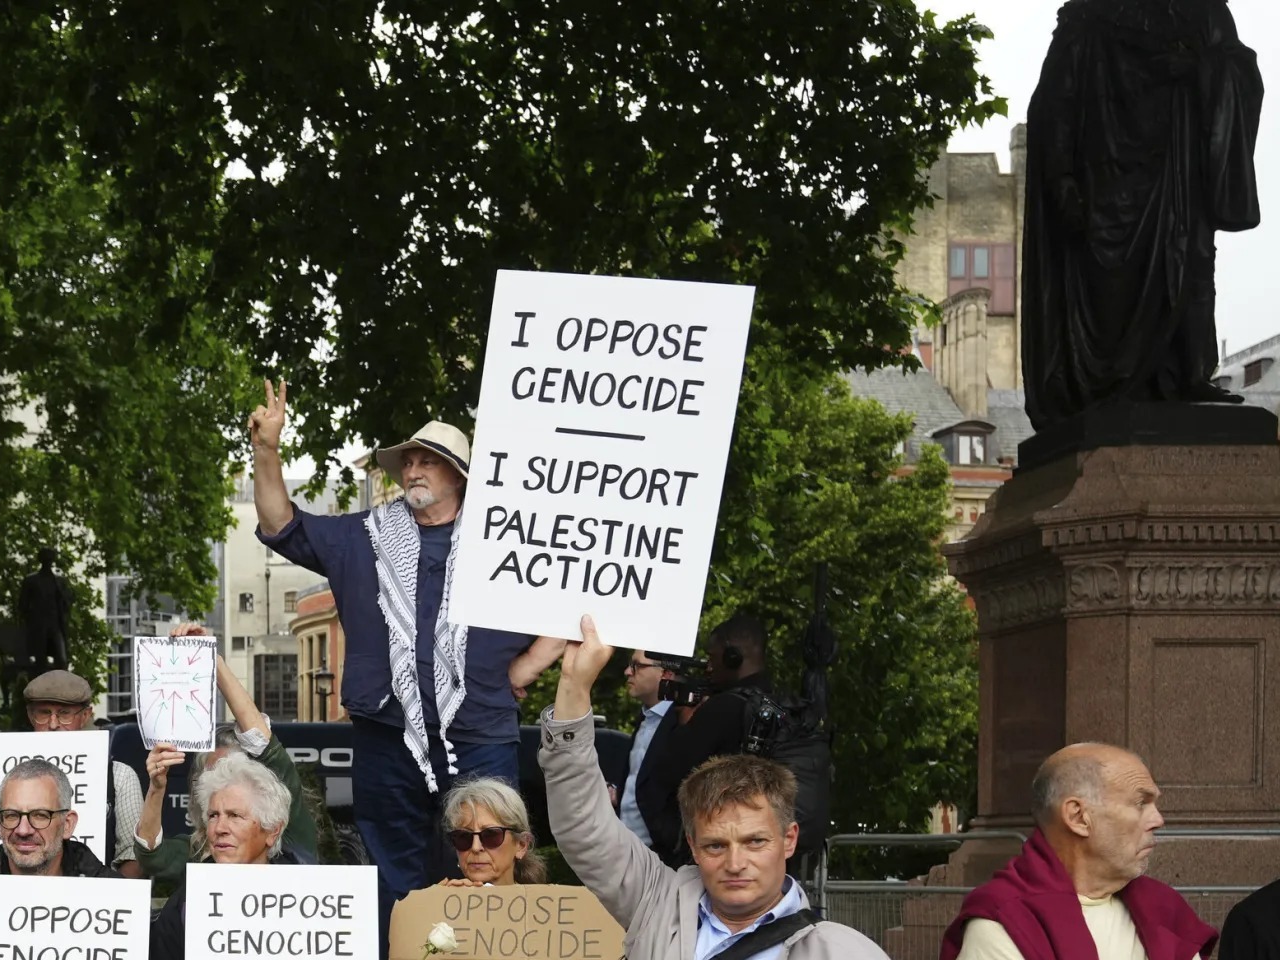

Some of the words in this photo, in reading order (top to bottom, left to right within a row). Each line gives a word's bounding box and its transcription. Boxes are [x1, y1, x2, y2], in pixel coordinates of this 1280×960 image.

[511, 312, 536, 347] I
[557, 318, 707, 362] OPPOSE
[512, 367, 704, 415] GENOCIDE
[486, 452, 508, 486] I
[523, 456, 698, 506] SUPPORT
[484, 506, 683, 564] PALESTINE
[489, 551, 652, 600] ACTION
[8, 905, 133, 936] OPPOSE
[208, 892, 224, 918] I
[240, 893, 354, 920] OPPOSE
[443, 894, 579, 925] OPPOSE
[207, 929, 354, 957] GENOCIDE
[453, 927, 603, 959] ENOCIDE
